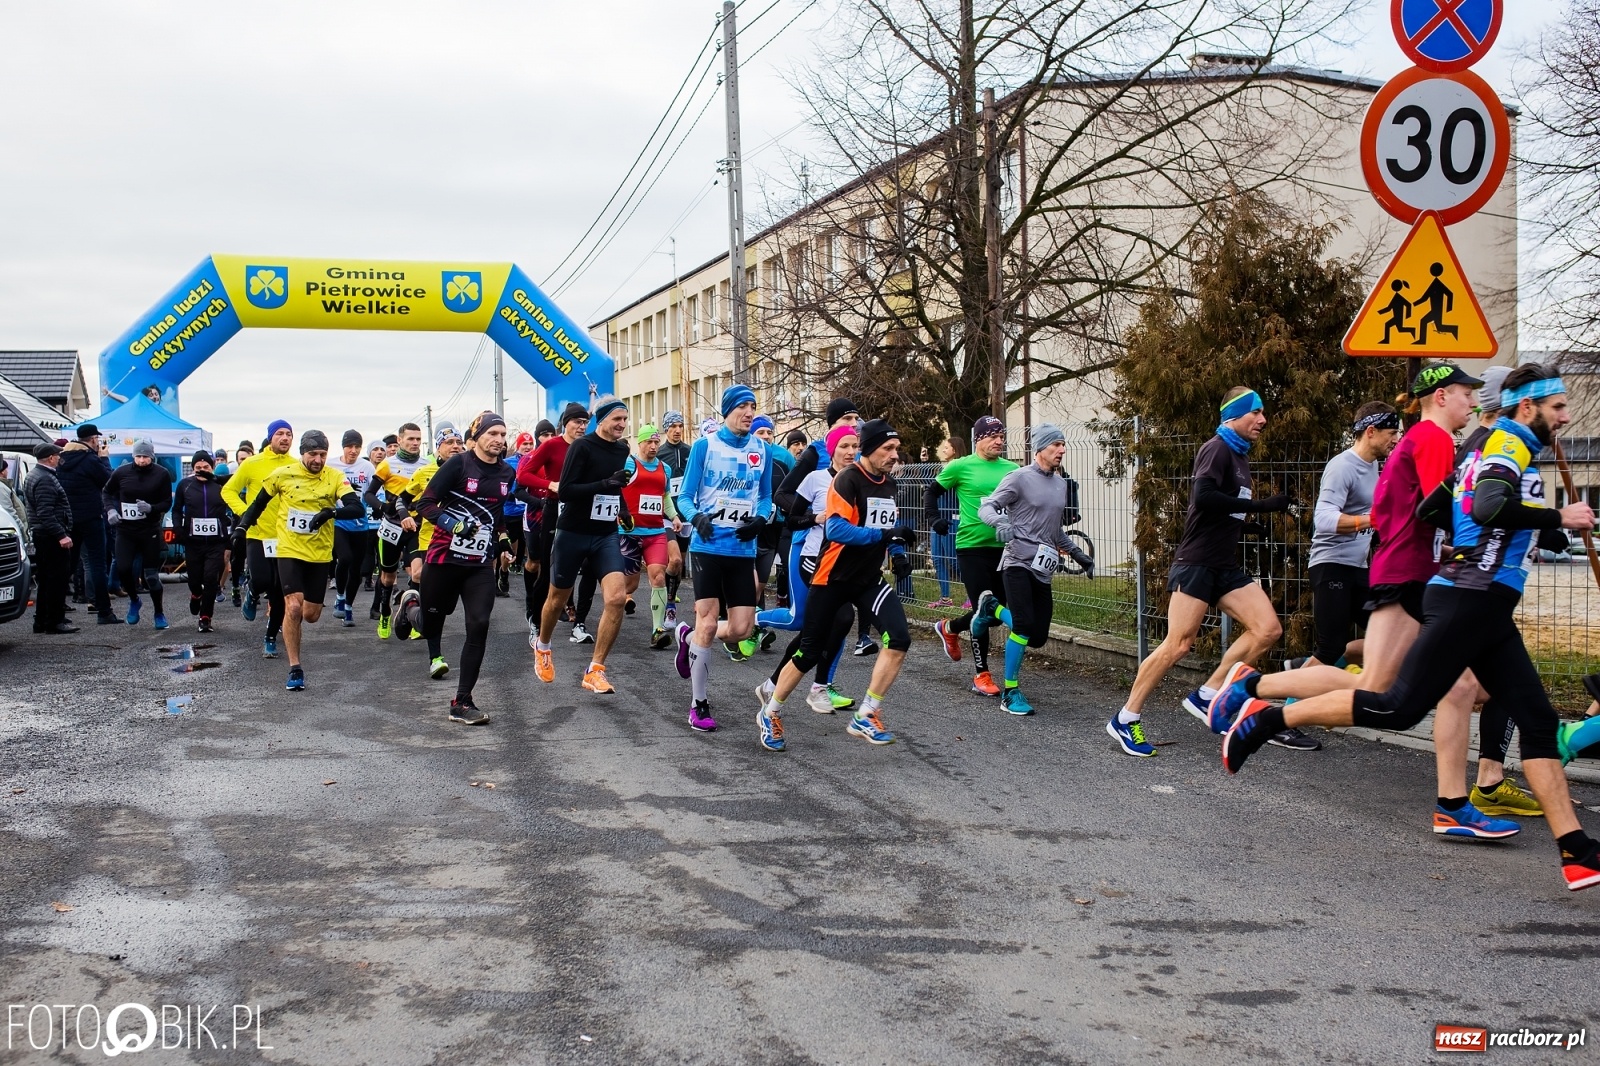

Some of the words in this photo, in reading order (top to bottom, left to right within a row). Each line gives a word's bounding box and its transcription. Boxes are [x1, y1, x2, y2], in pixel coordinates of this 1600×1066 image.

[1386, 105, 1486, 185] 30
[326, 267, 405, 280] Gmina
[305, 281, 427, 298] Pietrowice
[321, 299, 411, 315] Wielkie
[129, 313, 177, 356] Gmina
[172, 278, 214, 316] ludzi
[148, 297, 228, 370] aktywnych
[512, 288, 555, 332] Gmina
[552, 327, 590, 364] ludzi
[499, 305, 573, 376] aktywnych
[594, 503, 620, 517] 113
[640, 501, 662, 512] 440
[289, 516, 308, 530] 13
[717, 508, 751, 524] 144
[870, 509, 896, 526] 164
[194, 524, 217, 533] 366
[453, 536, 487, 551] 326
[1037, 554, 1058, 572] 108
